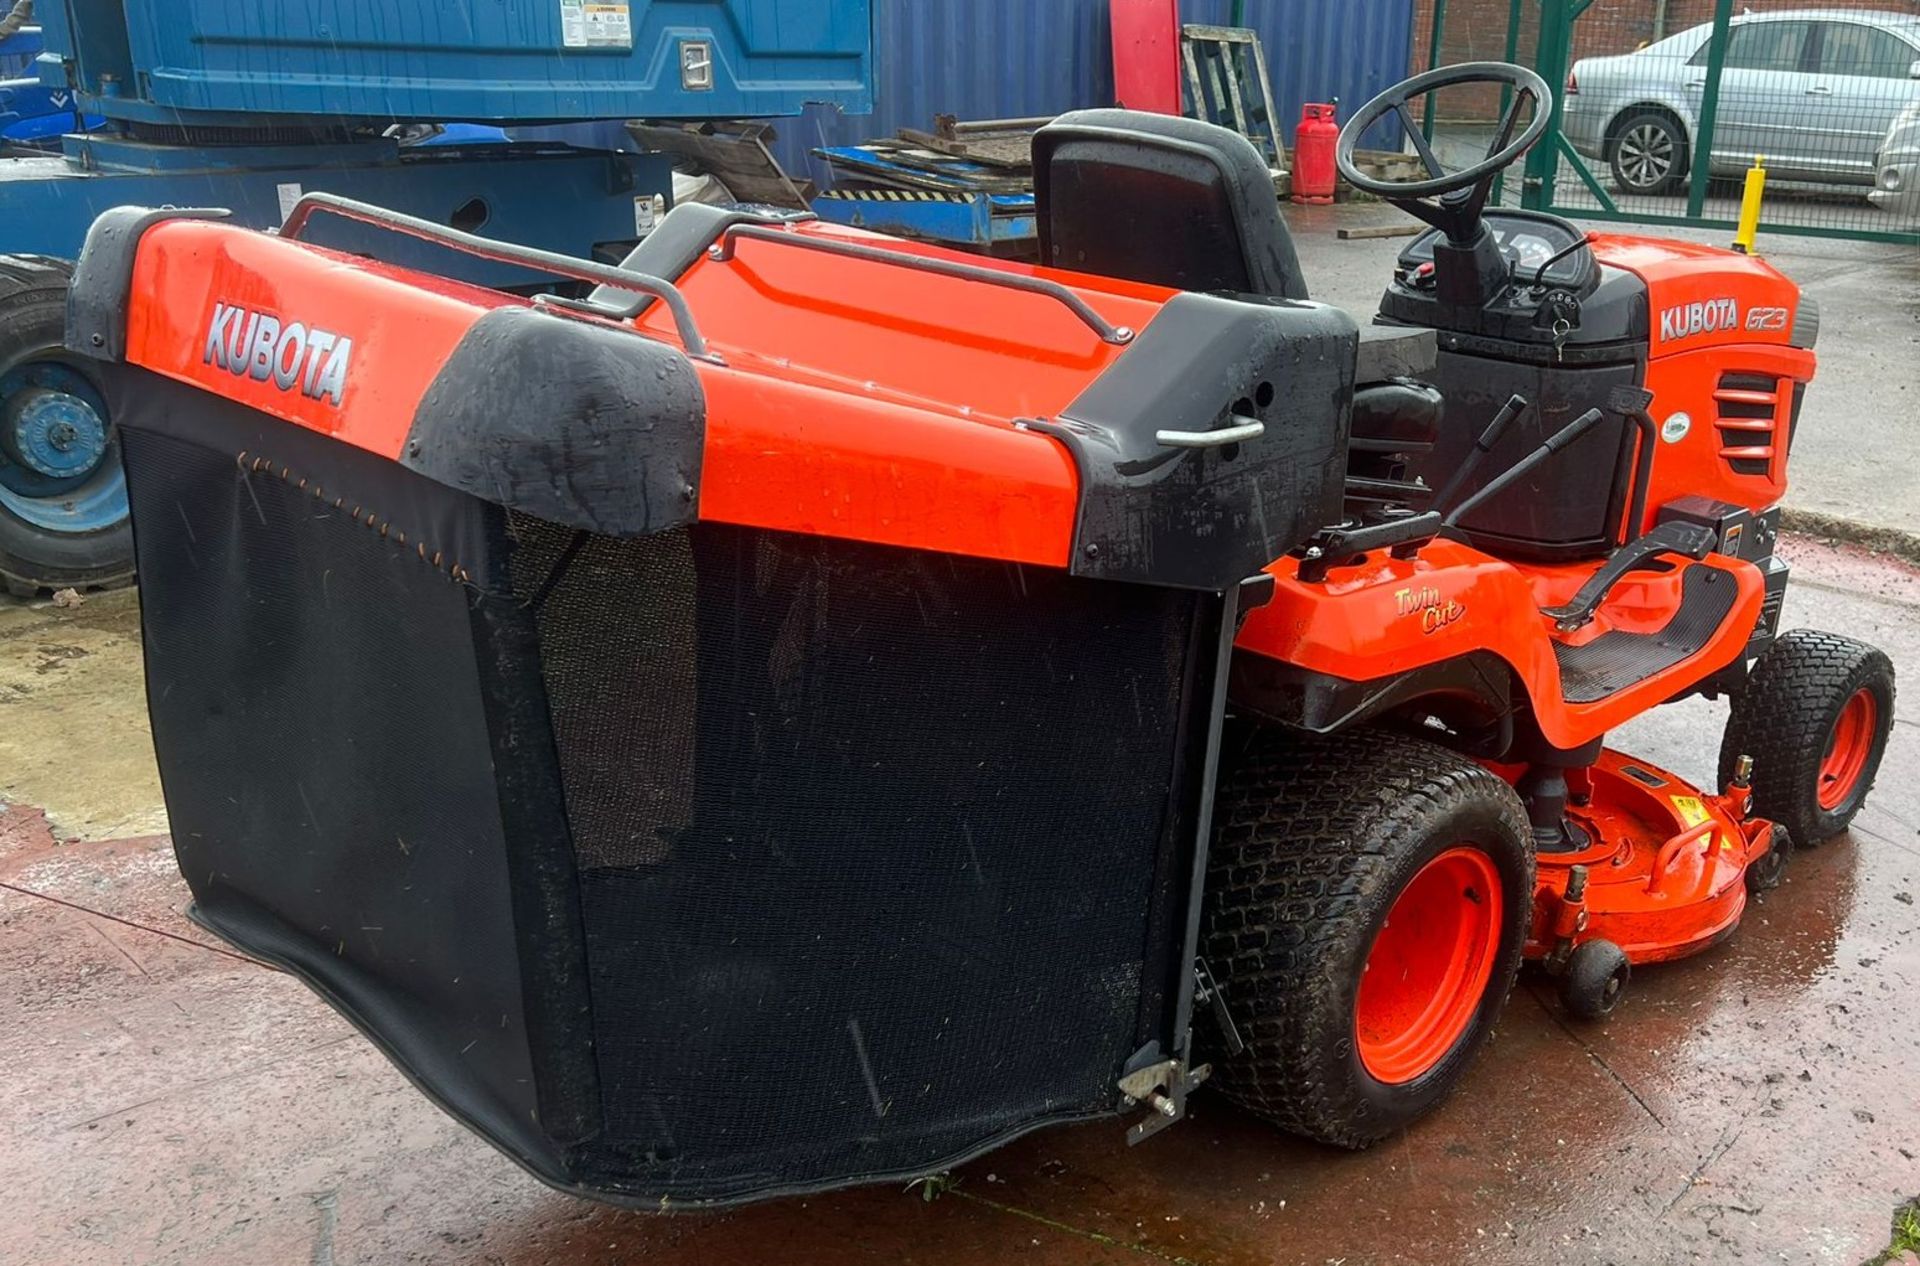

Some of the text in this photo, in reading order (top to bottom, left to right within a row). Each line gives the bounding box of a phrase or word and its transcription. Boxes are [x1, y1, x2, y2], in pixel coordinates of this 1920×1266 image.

[1660, 298, 1788, 342] KUBOTA G23
[204, 302, 353, 406] KUBOTA
[1395, 587, 1441, 616] Twin
[1423, 601, 1465, 634] Cut
